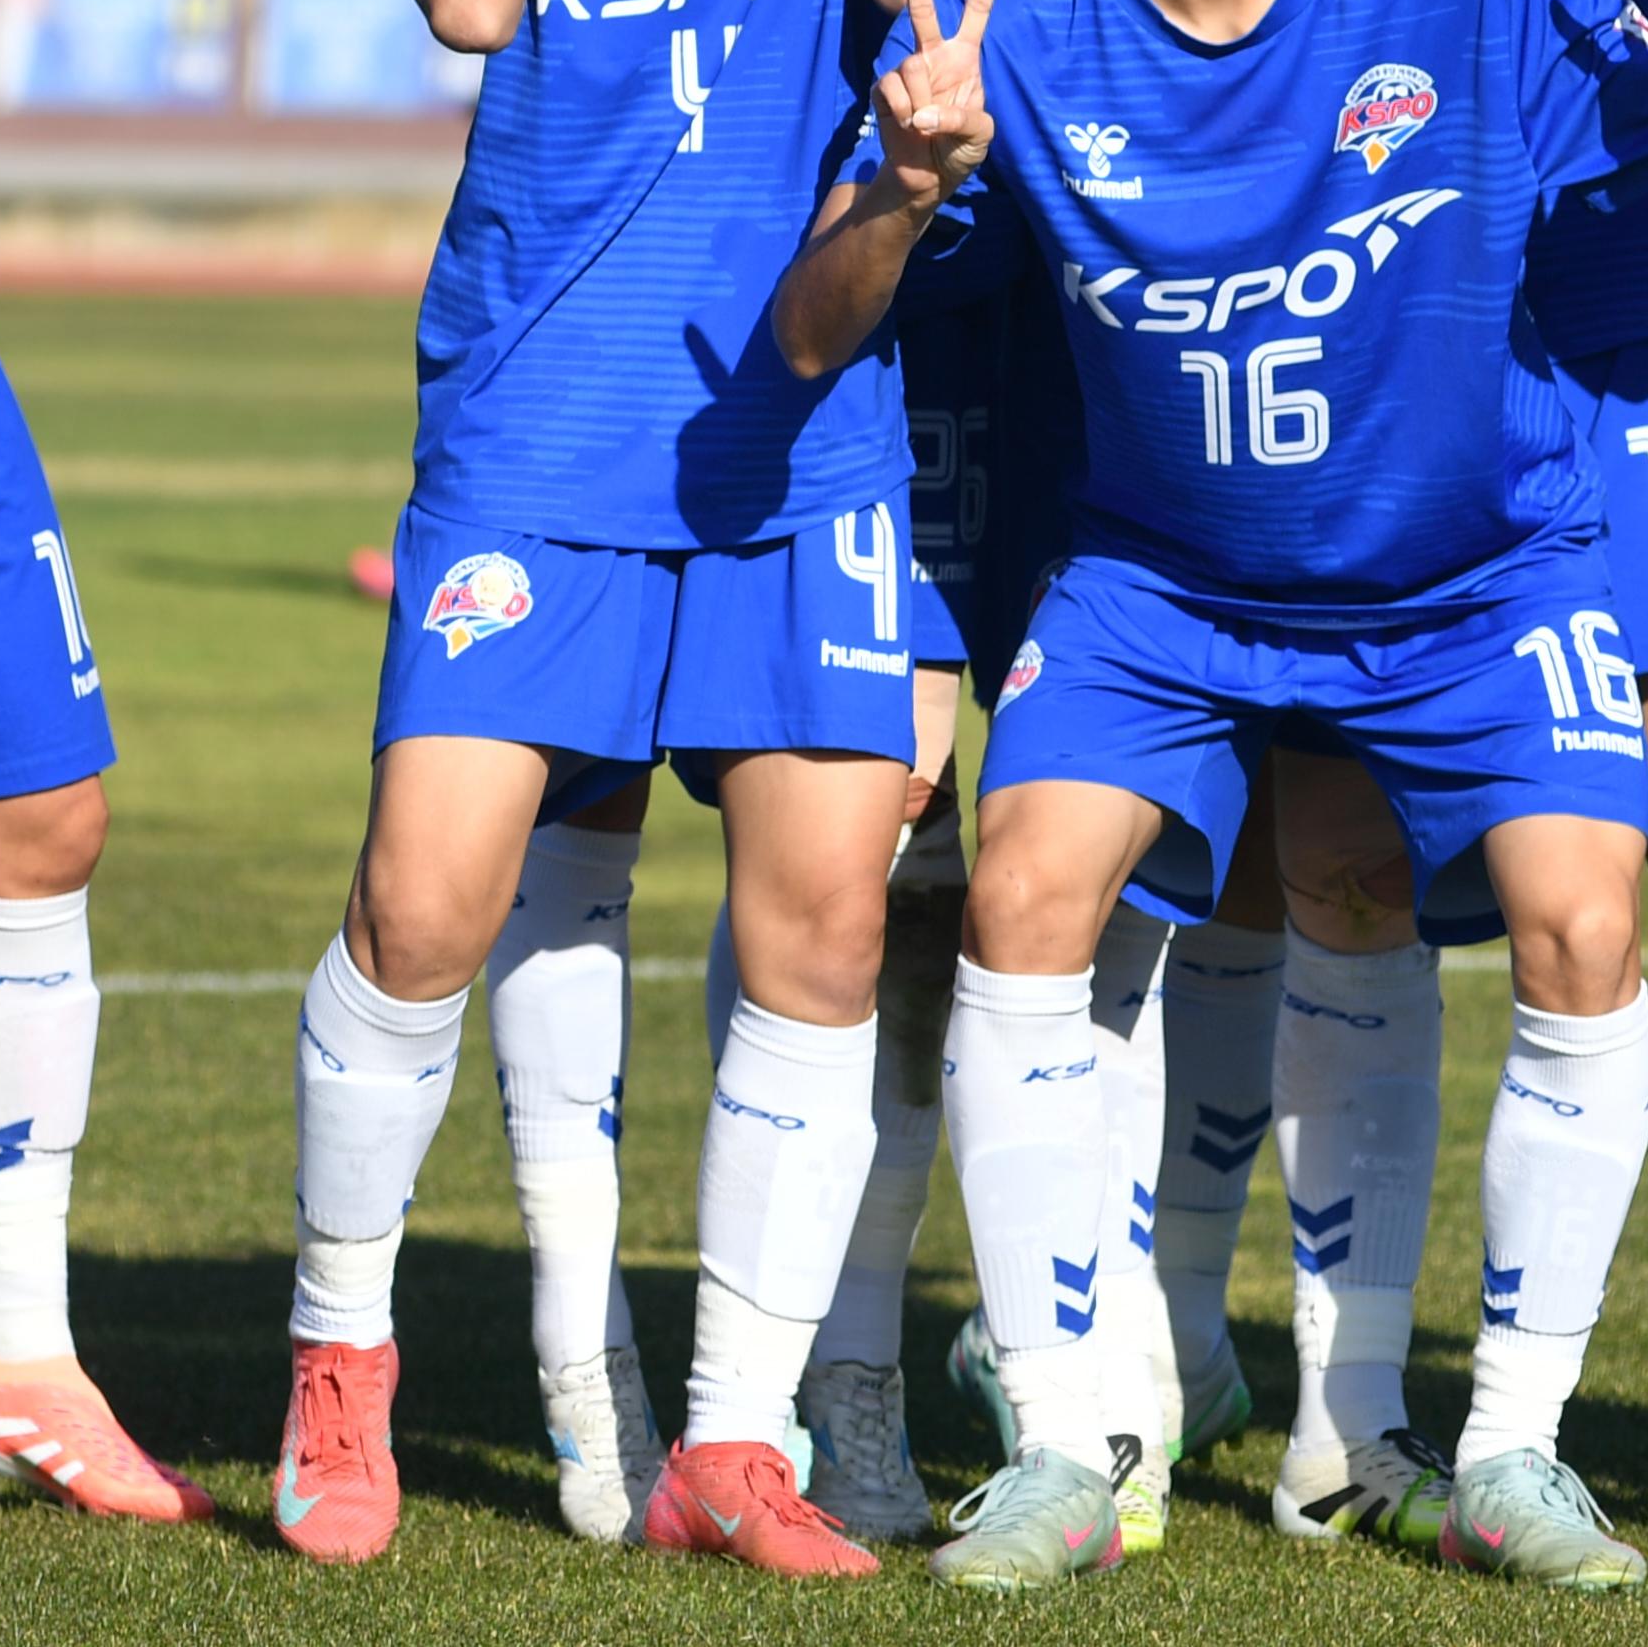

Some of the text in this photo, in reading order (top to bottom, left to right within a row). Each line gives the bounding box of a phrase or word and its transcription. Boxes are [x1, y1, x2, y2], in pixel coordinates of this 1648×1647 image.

[1339, 90, 1434, 146] KSPO
[1061, 169, 1144, 201] hummel
[1063, 249, 1357, 333] KSPO
[1180, 336, 1329, 466] 16
[34, 529, 92, 665] 1
[834, 502, 897, 641] 4
[821, 638, 908, 677] hummel
[1513, 610, 1644, 728] 16
[1552, 727, 1644, 761] hummel
